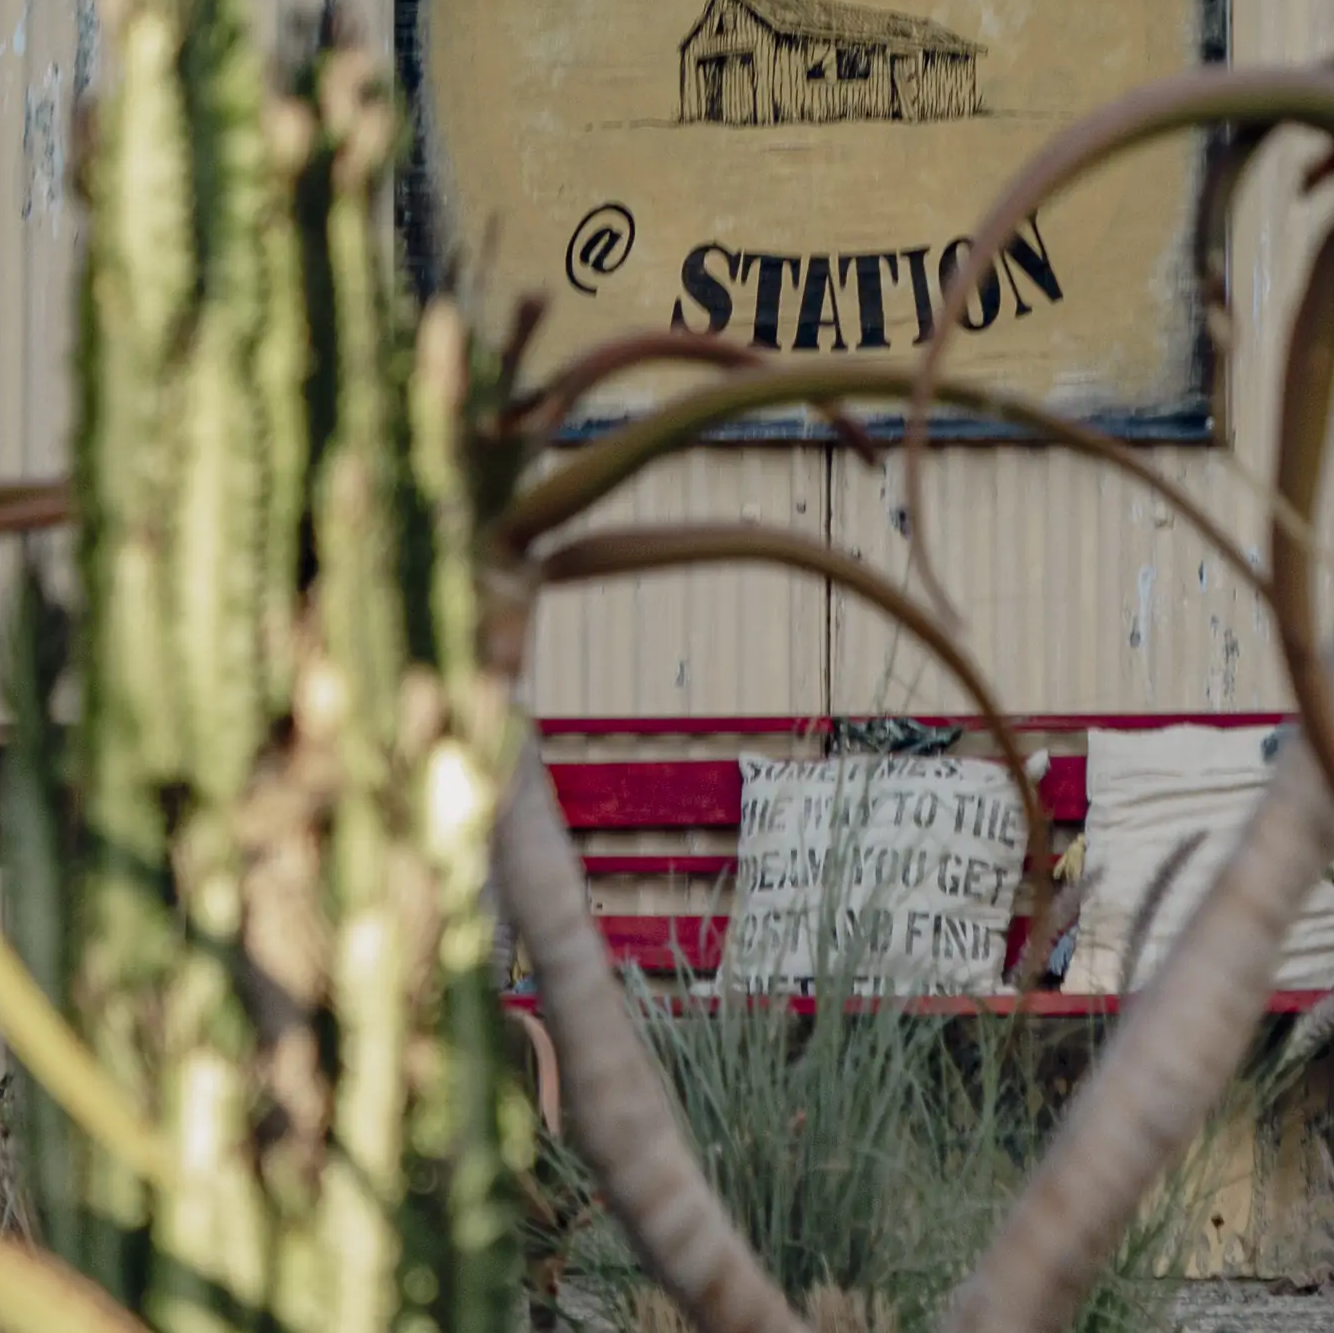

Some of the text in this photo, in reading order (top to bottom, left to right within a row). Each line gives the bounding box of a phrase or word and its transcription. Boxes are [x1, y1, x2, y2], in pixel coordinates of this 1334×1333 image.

[565, 201, 1064, 351] @ STATION
[892, 792, 939, 829] TO
[937, 853, 1009, 907] GET
